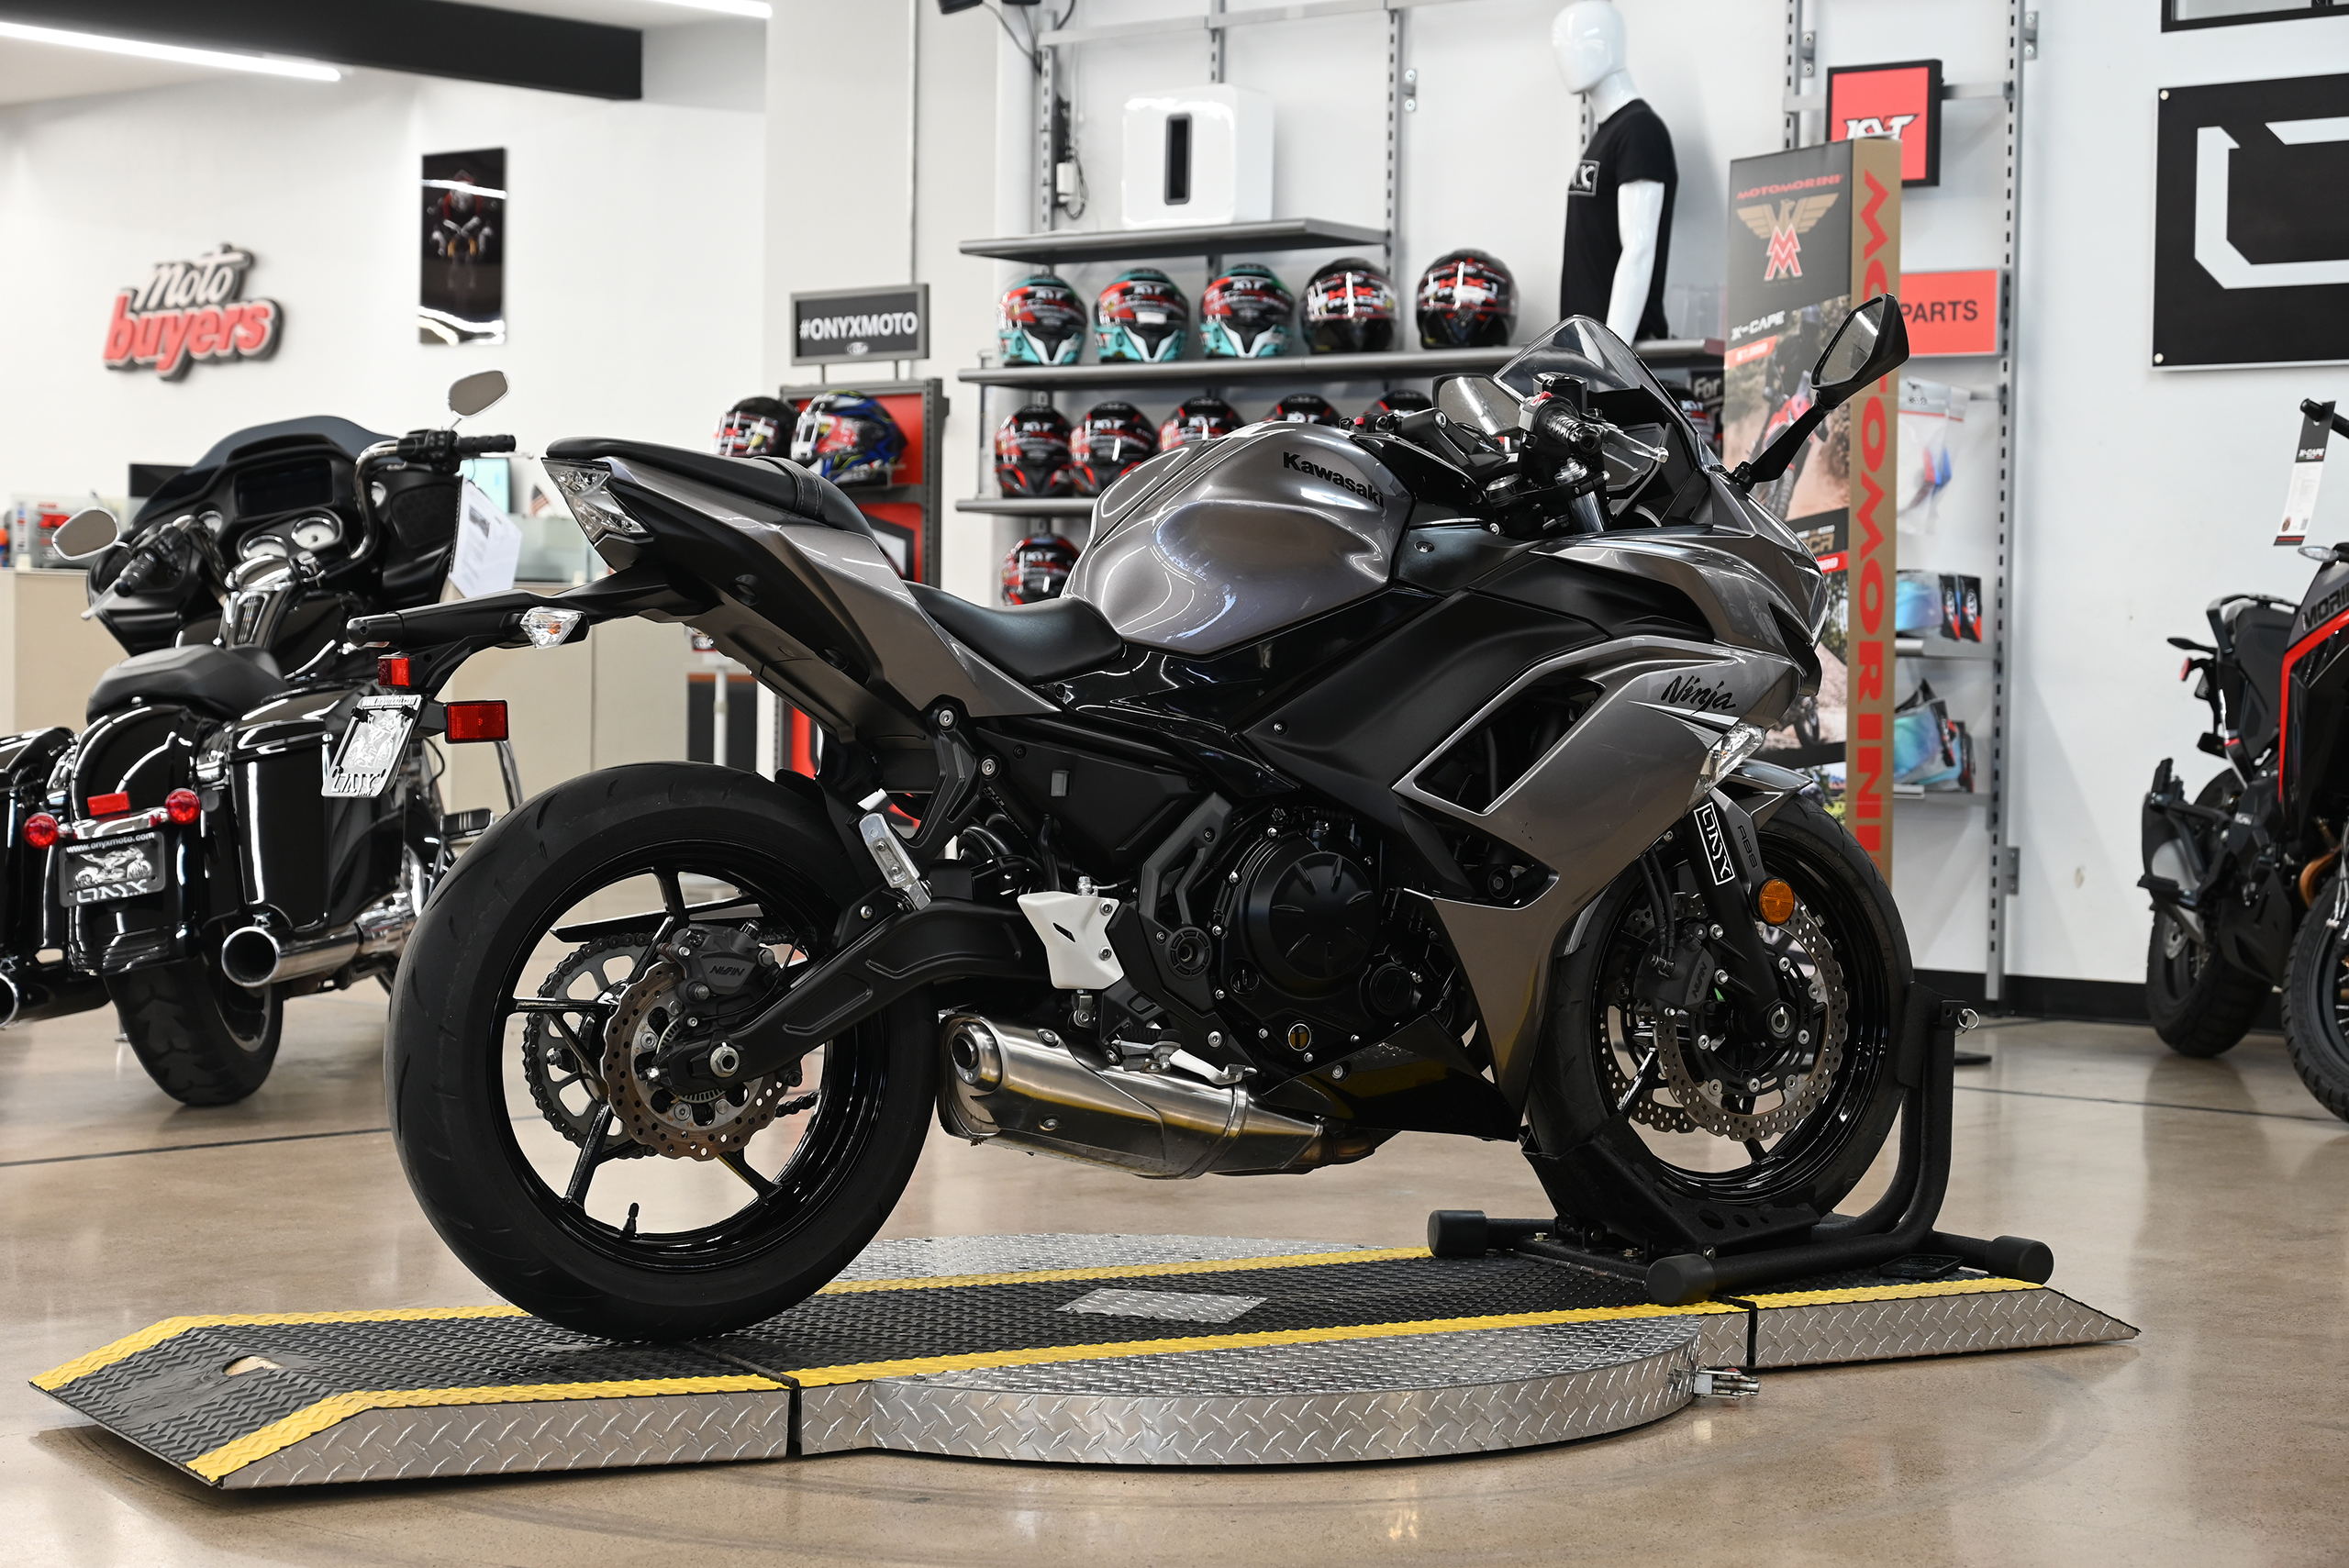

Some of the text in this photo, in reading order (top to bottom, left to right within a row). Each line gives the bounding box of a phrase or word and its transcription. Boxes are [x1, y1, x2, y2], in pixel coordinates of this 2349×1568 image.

[1737, 174, 1841, 199] MOTOMORINI
[799, 311, 918, 340] #ONYXMOTO
[1731, 310, 1786, 341] X-CAPE
[1899, 299, 1978, 323] PARTS
[103, 292, 273, 372] buyers
[1283, 451, 1385, 509] Kawasaki
[1660, 675, 1737, 716] Ninja
[66, 832, 155, 853] www.onyxmoto.com
[1737, 825, 1758, 869] ABS
